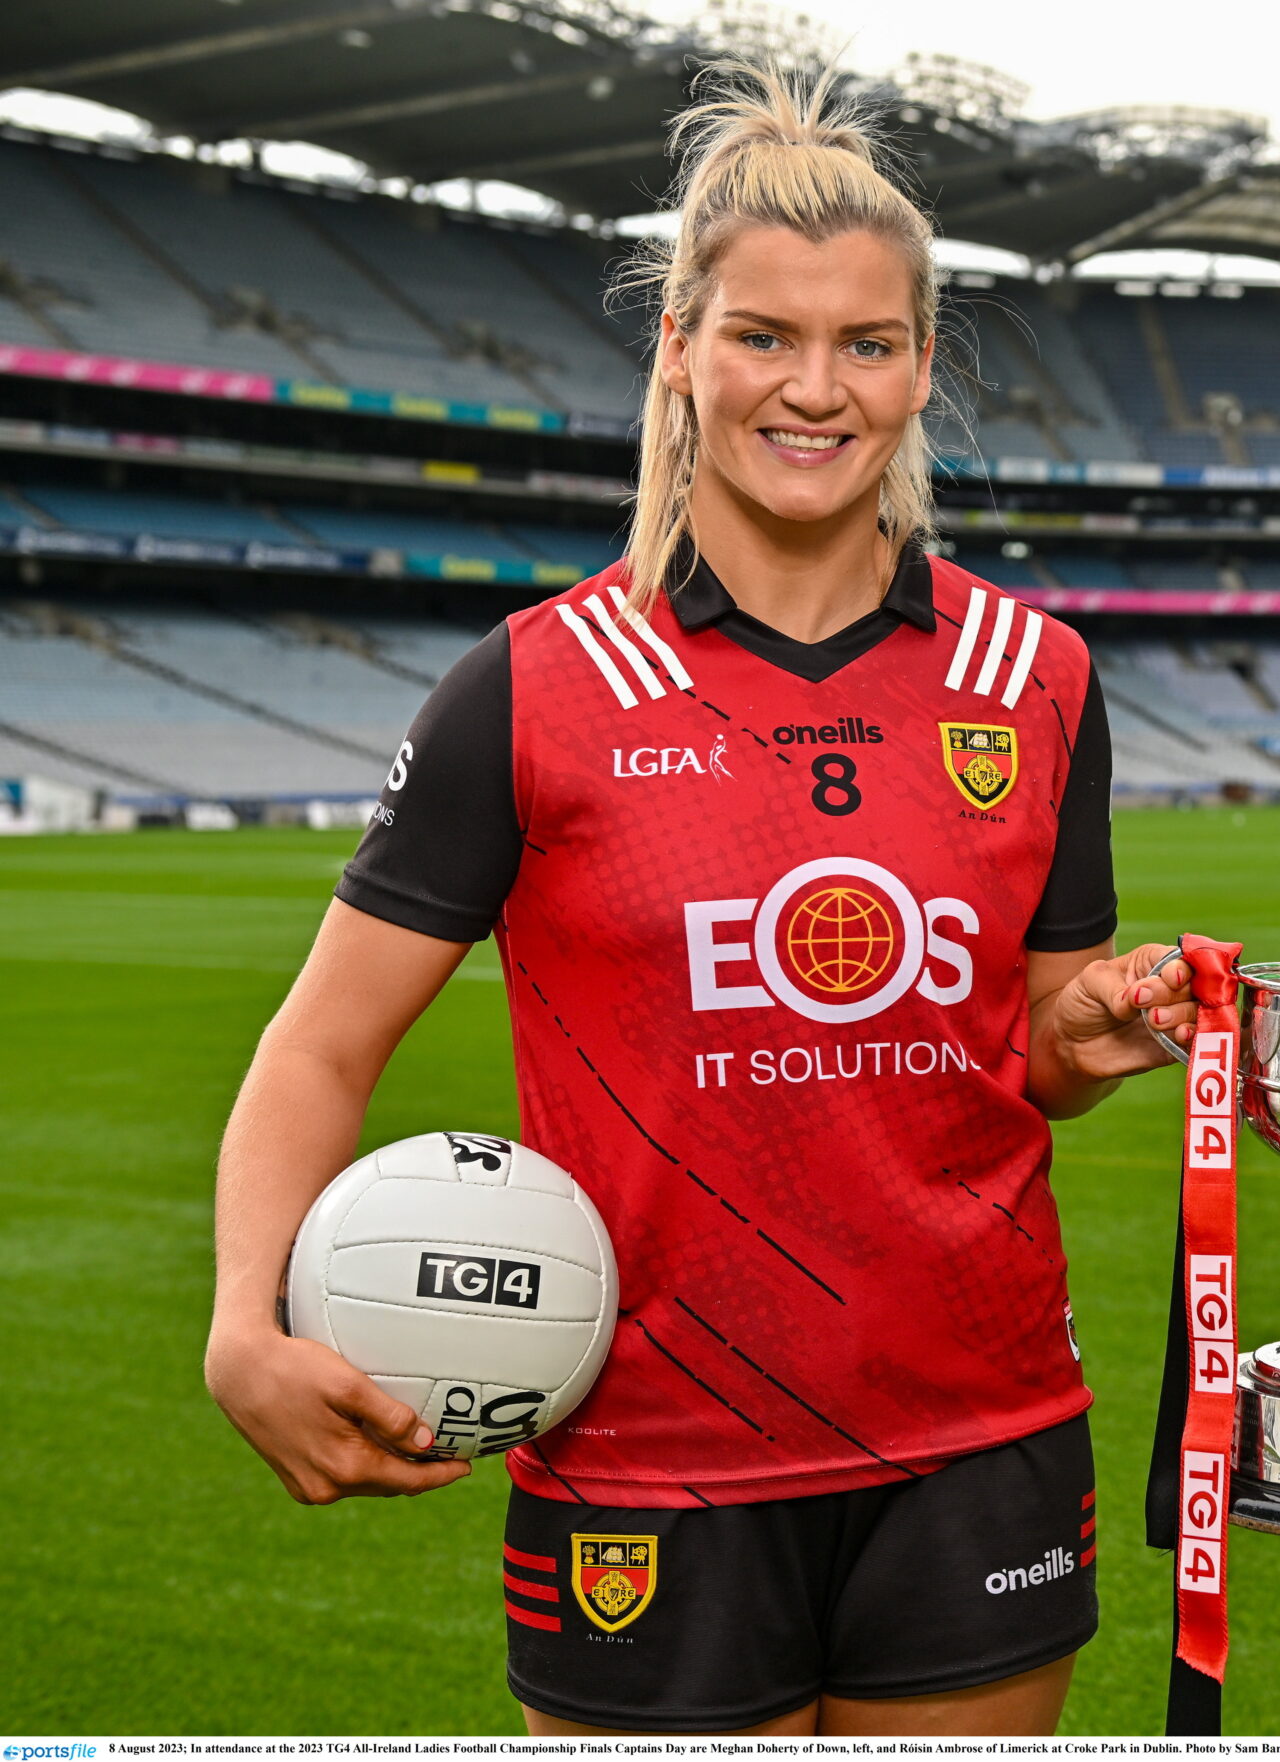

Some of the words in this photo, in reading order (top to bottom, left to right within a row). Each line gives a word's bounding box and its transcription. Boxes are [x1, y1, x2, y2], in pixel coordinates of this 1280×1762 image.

[612, 747, 707, 777] LGFA
[811, 753, 862, 816] 8
[958, 809, 977, 820] An
[980, 812, 1007, 824] Dún
[684, 856, 980, 1024] EOS
[695, 1052, 734, 1088] IT
[1194, 1037, 1229, 1160] TG4
[426, 1258, 533, 1303] TG4
[1195, 1261, 1230, 1384] TG4
[568, 1427, 617, 1436] KOOLITE
[1184, 1460, 1222, 1584] TG4
[586, 1633, 602, 1642] An
